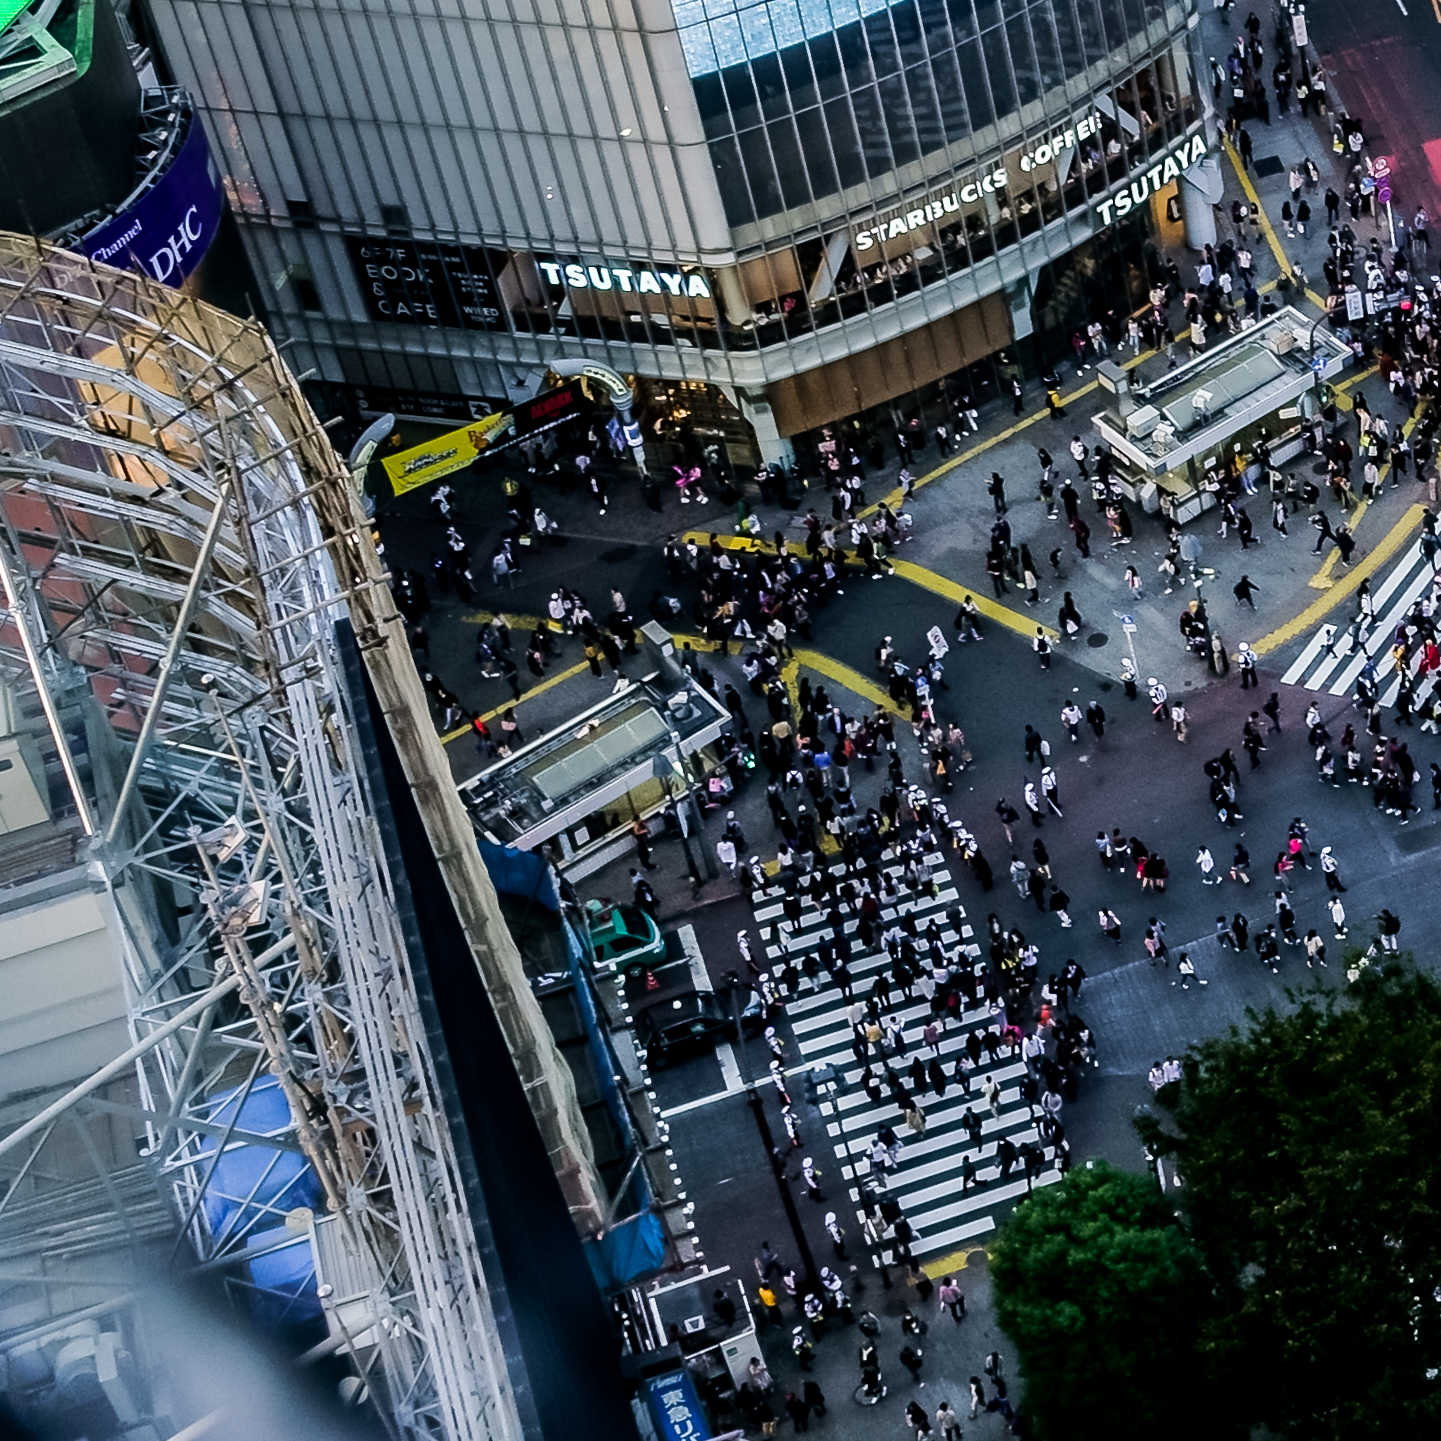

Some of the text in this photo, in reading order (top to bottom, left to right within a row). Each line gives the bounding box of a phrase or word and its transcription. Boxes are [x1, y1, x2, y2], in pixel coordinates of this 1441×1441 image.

[856, 165, 1010, 251] STARBUCKS
[1097, 133, 1208, 227] TSUTAYA
[148, 204, 204, 284] DHC
[539, 261, 711, 299] TSUTAYA
